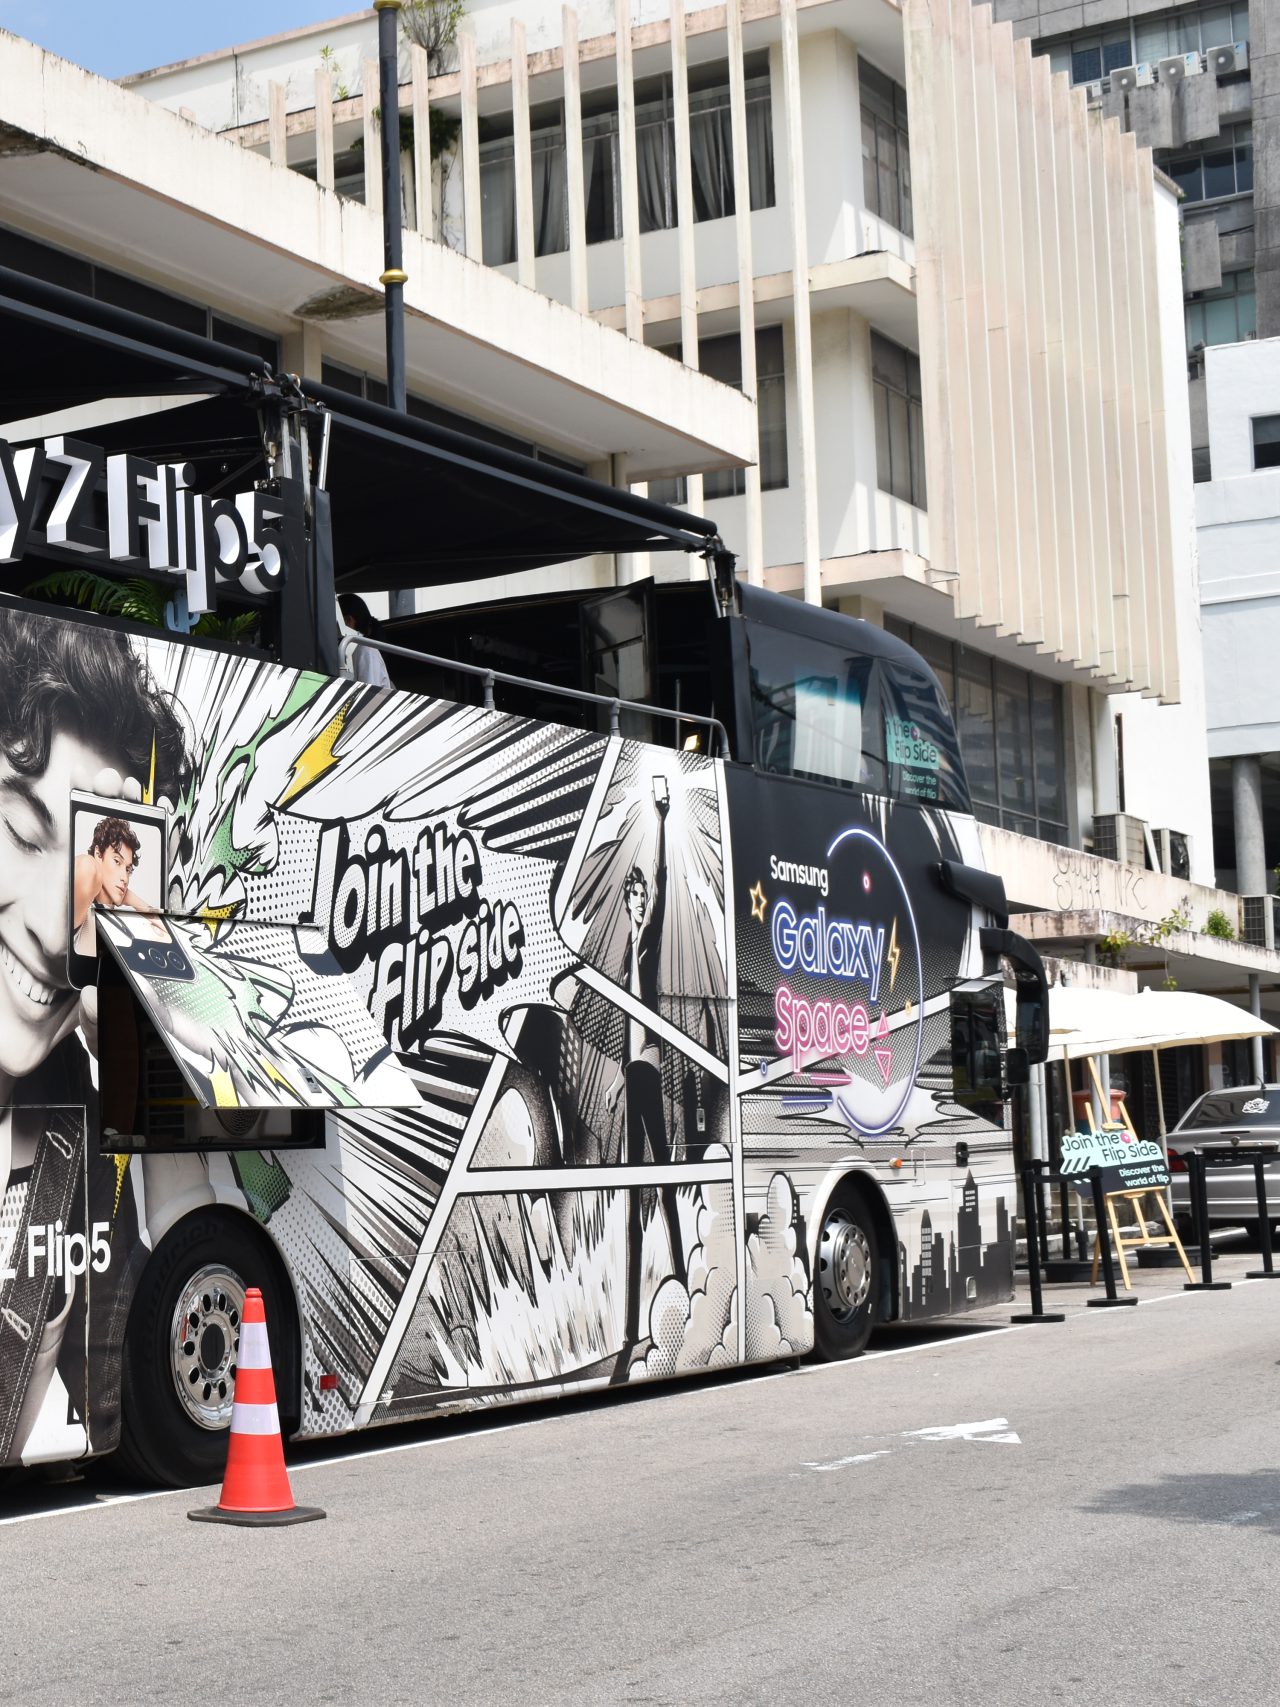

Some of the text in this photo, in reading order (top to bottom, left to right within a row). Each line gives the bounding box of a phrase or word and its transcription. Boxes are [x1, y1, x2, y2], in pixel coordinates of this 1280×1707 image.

[44, 435, 106, 553] Z
[107, 453, 289, 614] Flip5
[913, 744, 937, 763] Side
[300, 818, 481, 962] Join the
[770, 855, 828, 896] Samsung
[456, 898, 524, 1004] side
[773, 902, 884, 1001] Galaxy
[775, 986, 869, 1073] Space
[1064, 1133, 1120, 1152] Join the
[1101, 1143, 1158, 1164] Flip Side
[1118, 1164, 1165, 1177] Discover the
[1124, 1174, 1170, 1187] world of flip
[28, 1220, 112, 1295] Flip5
